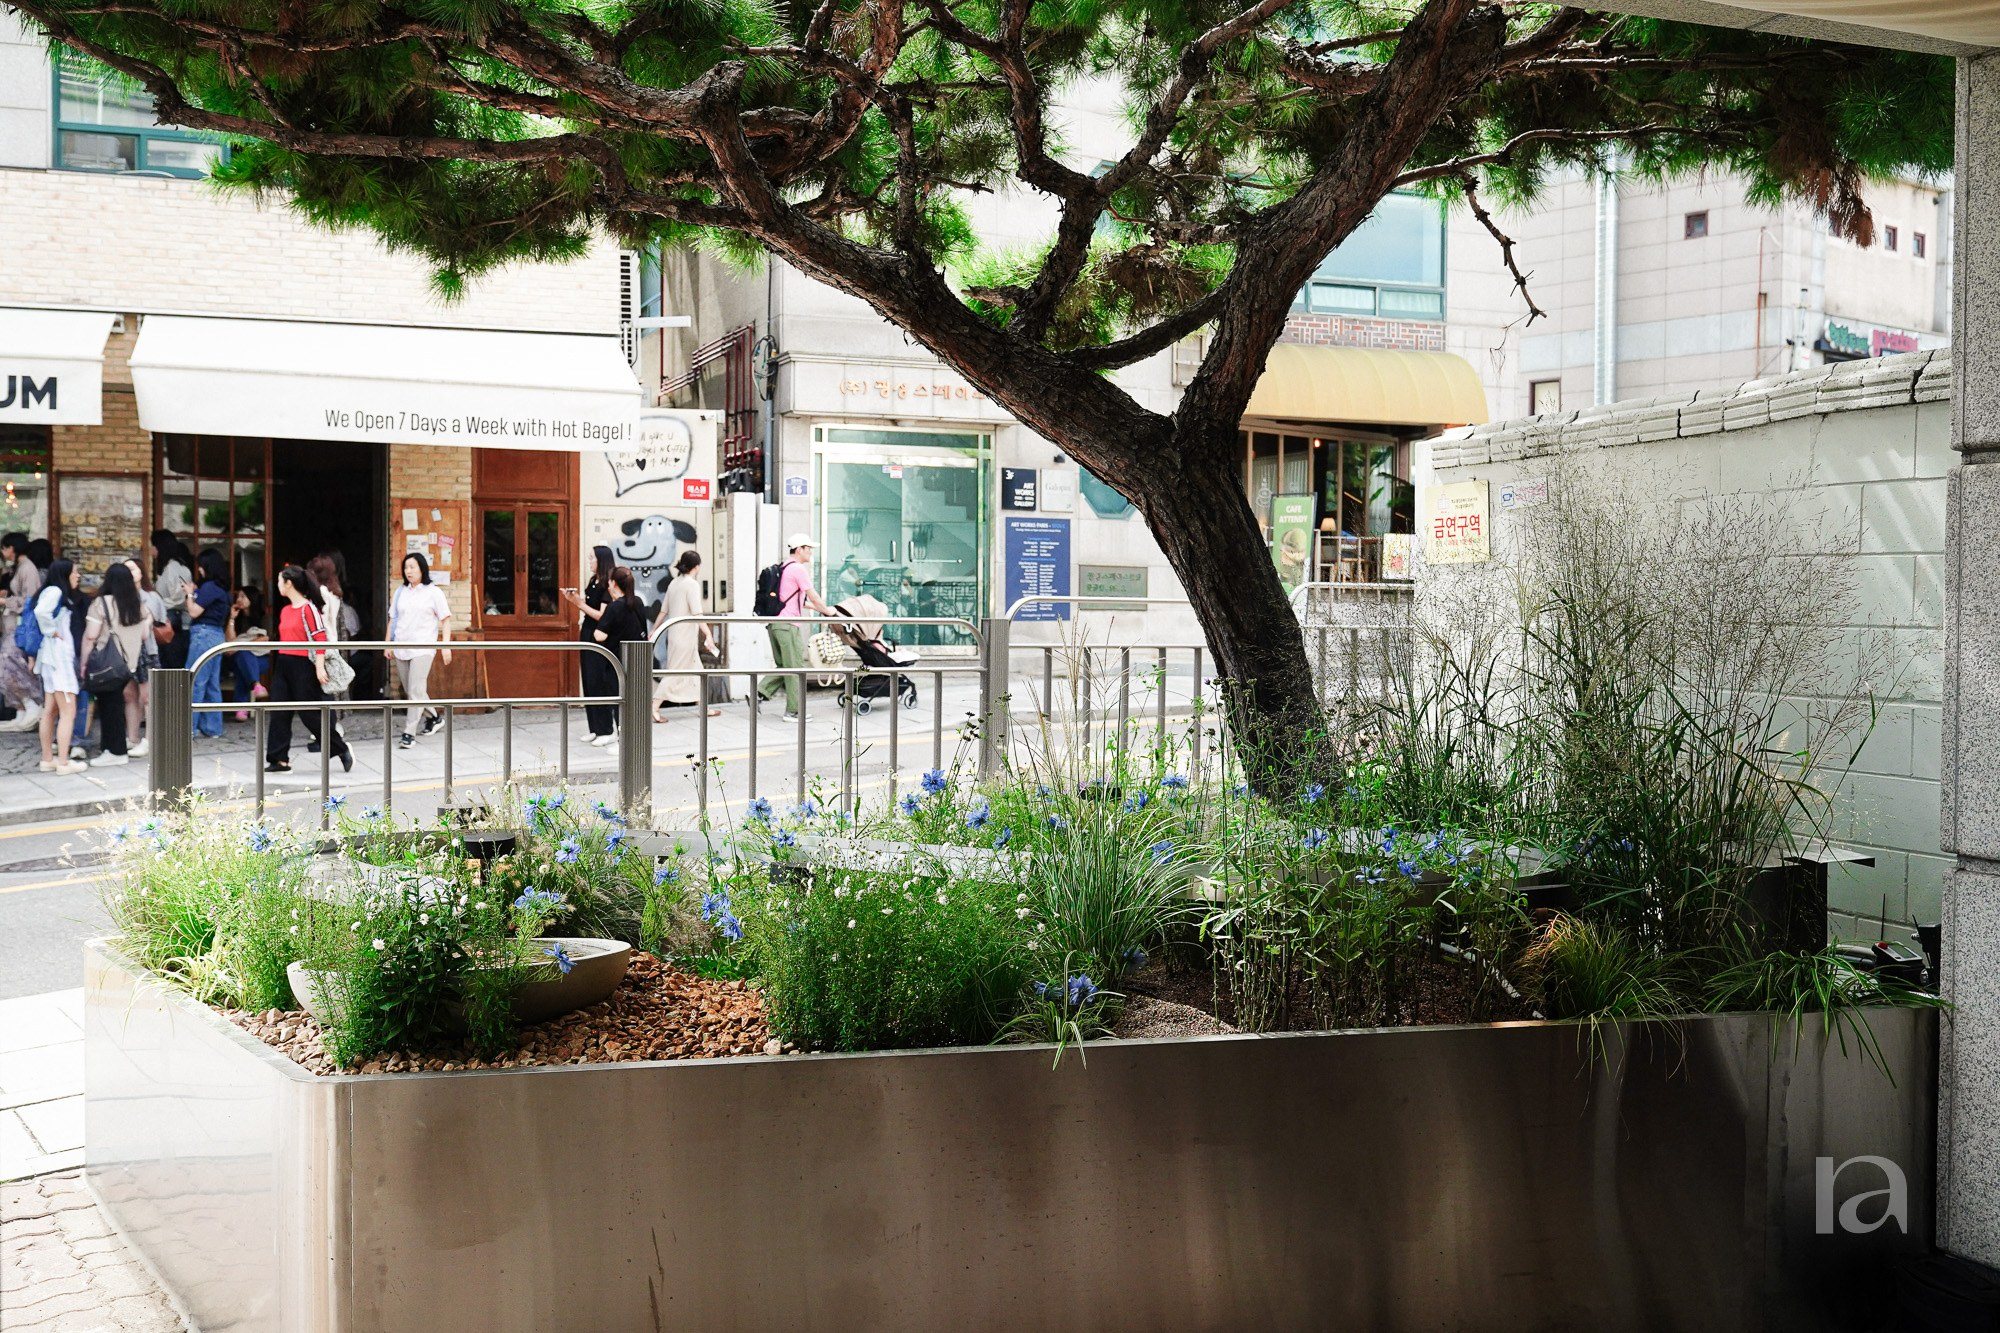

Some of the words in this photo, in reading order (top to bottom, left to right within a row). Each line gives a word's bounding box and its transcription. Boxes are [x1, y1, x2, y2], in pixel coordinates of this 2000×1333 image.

[325, 409, 349, 428] We
[355, 410, 394, 433] Open
[399, 412, 406, 430] 7
[411, 413, 447, 435] Days
[452, 418, 461, 433] a
[466, 416, 508, 435] Week
[513, 419, 547, 437] with
[552, 420, 577, 438] Hot
[791, 485, 803, 495] 16
[1433, 514, 1481, 539] 금연구역
